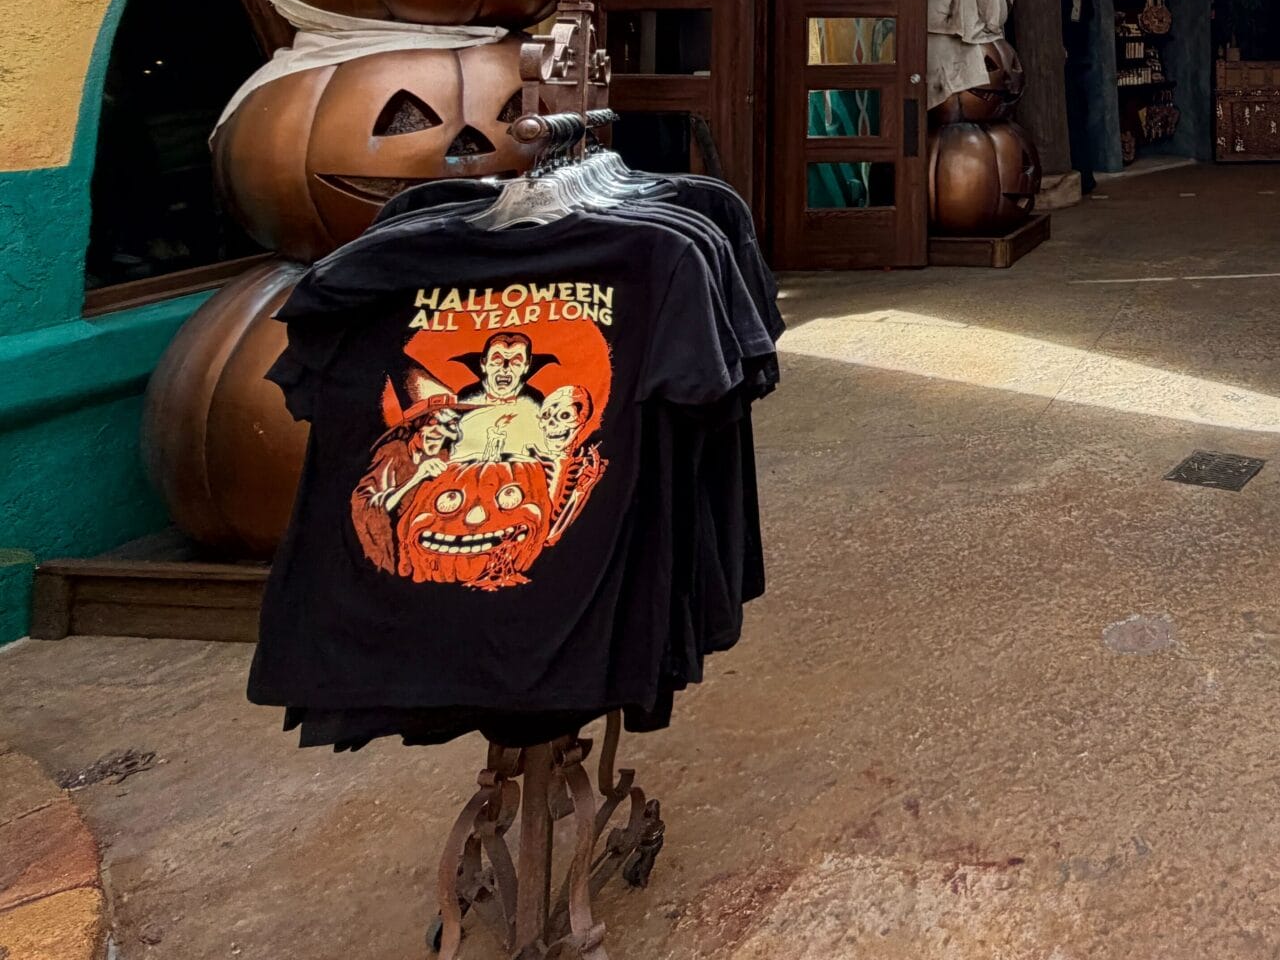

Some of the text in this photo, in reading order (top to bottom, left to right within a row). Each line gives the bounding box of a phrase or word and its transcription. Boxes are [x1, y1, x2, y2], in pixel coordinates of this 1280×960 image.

[414, 282, 614, 312] HALLOWEEN
[408, 302, 614, 331] ALL YEAR LONG
